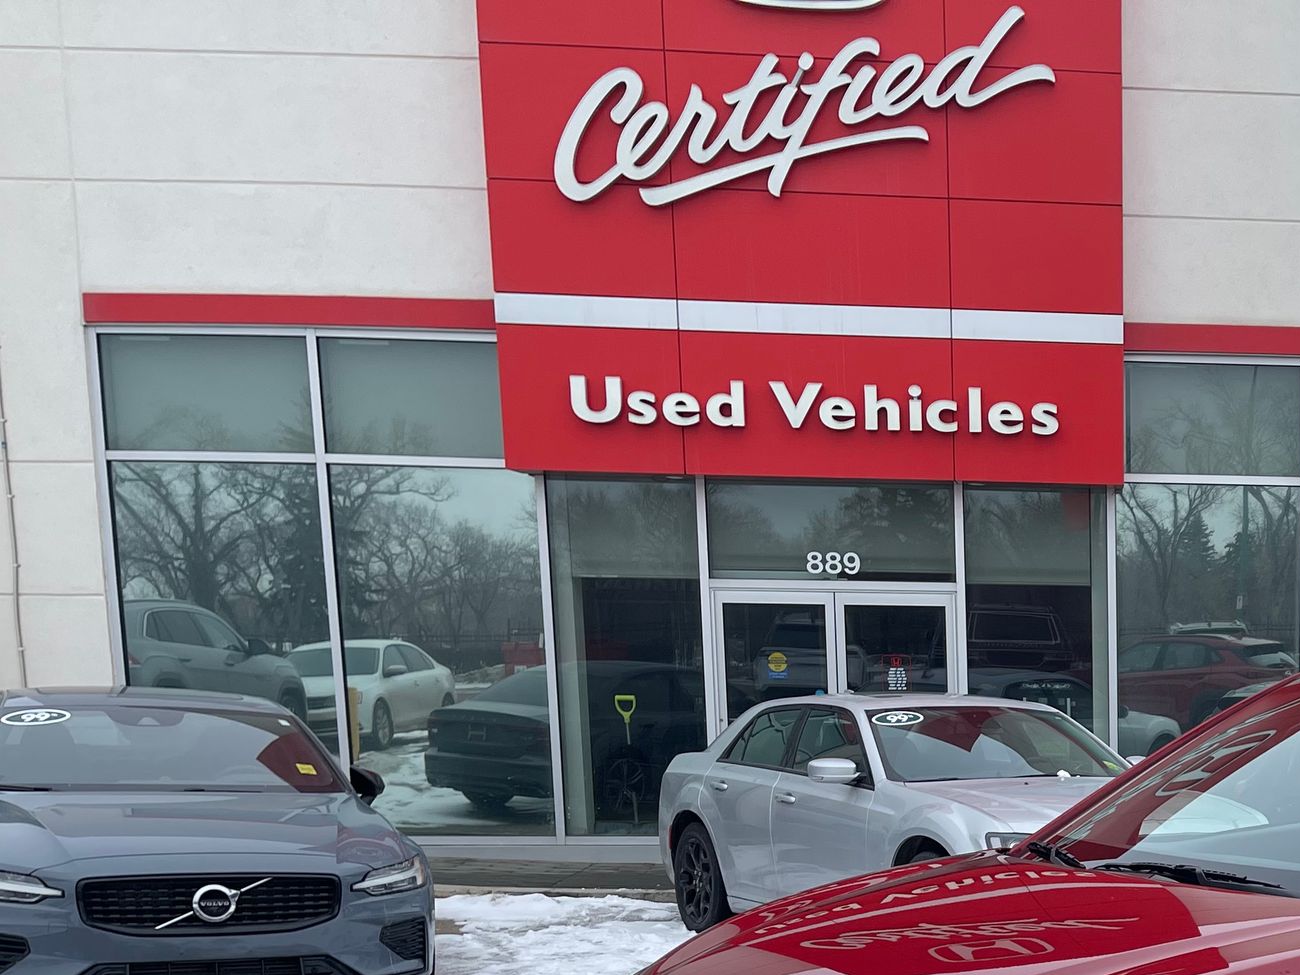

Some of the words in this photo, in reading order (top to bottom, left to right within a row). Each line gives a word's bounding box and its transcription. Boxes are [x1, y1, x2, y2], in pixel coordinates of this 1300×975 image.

[554, 6, 1056, 205] Certified
[569, 375, 746, 428] Used
[769, 381, 1060, 436] Vehicles
[806, 551, 861, 575] 889
